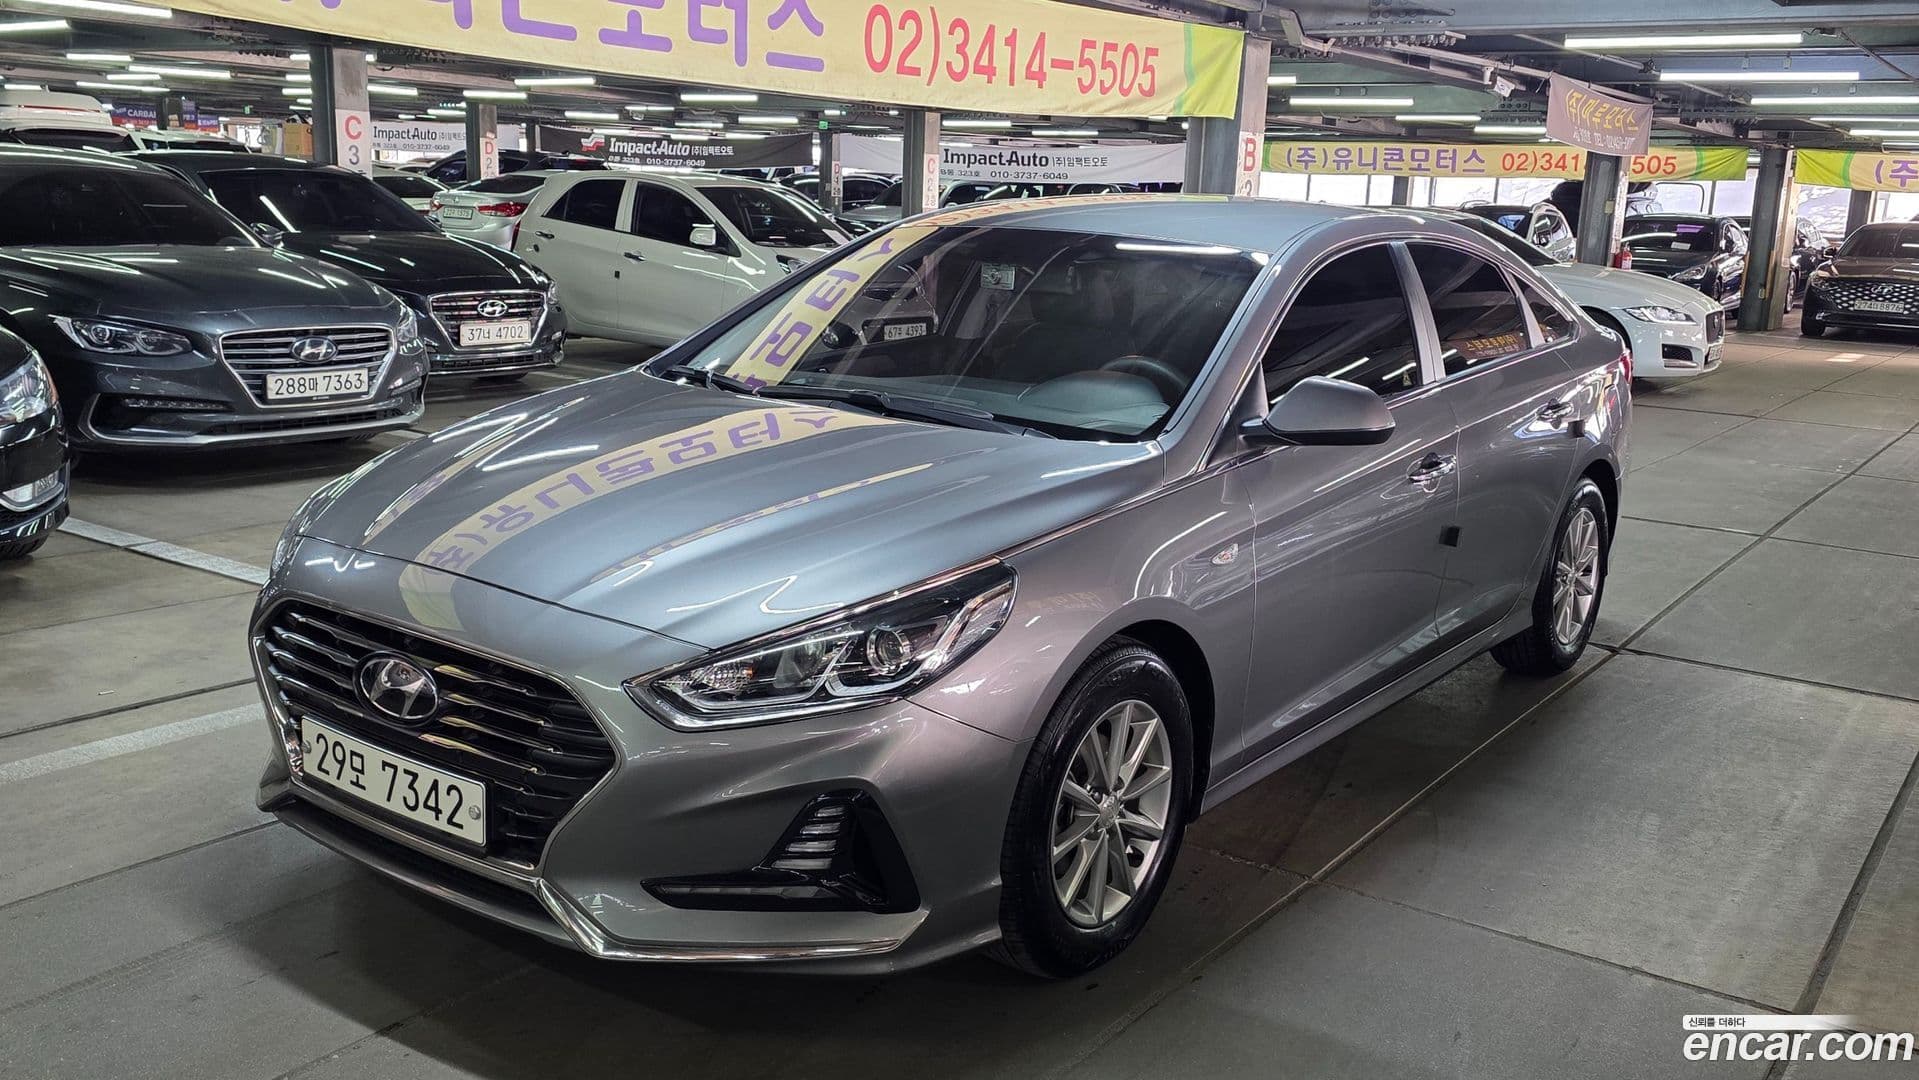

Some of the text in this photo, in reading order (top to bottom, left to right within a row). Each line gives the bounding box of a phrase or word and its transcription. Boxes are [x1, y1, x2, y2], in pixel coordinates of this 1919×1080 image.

[864, 3, 1159, 97] 02)3414-5505
[344, 115, 362, 140] C
[348, 144, 360, 166] 3
[484, 141, 494, 155] D
[1243, 137, 1257, 172] B
[486, 157, 493, 170] 2
[833, 163, 841, 174] D
[927, 157, 936, 174] C
[1286, 146, 1486, 174] (주)유니콘모터스
[496, 325, 524, 339] 4702
[274, 373, 364, 396] 288마 7363
[316, 733, 464, 830] 29모 7342
